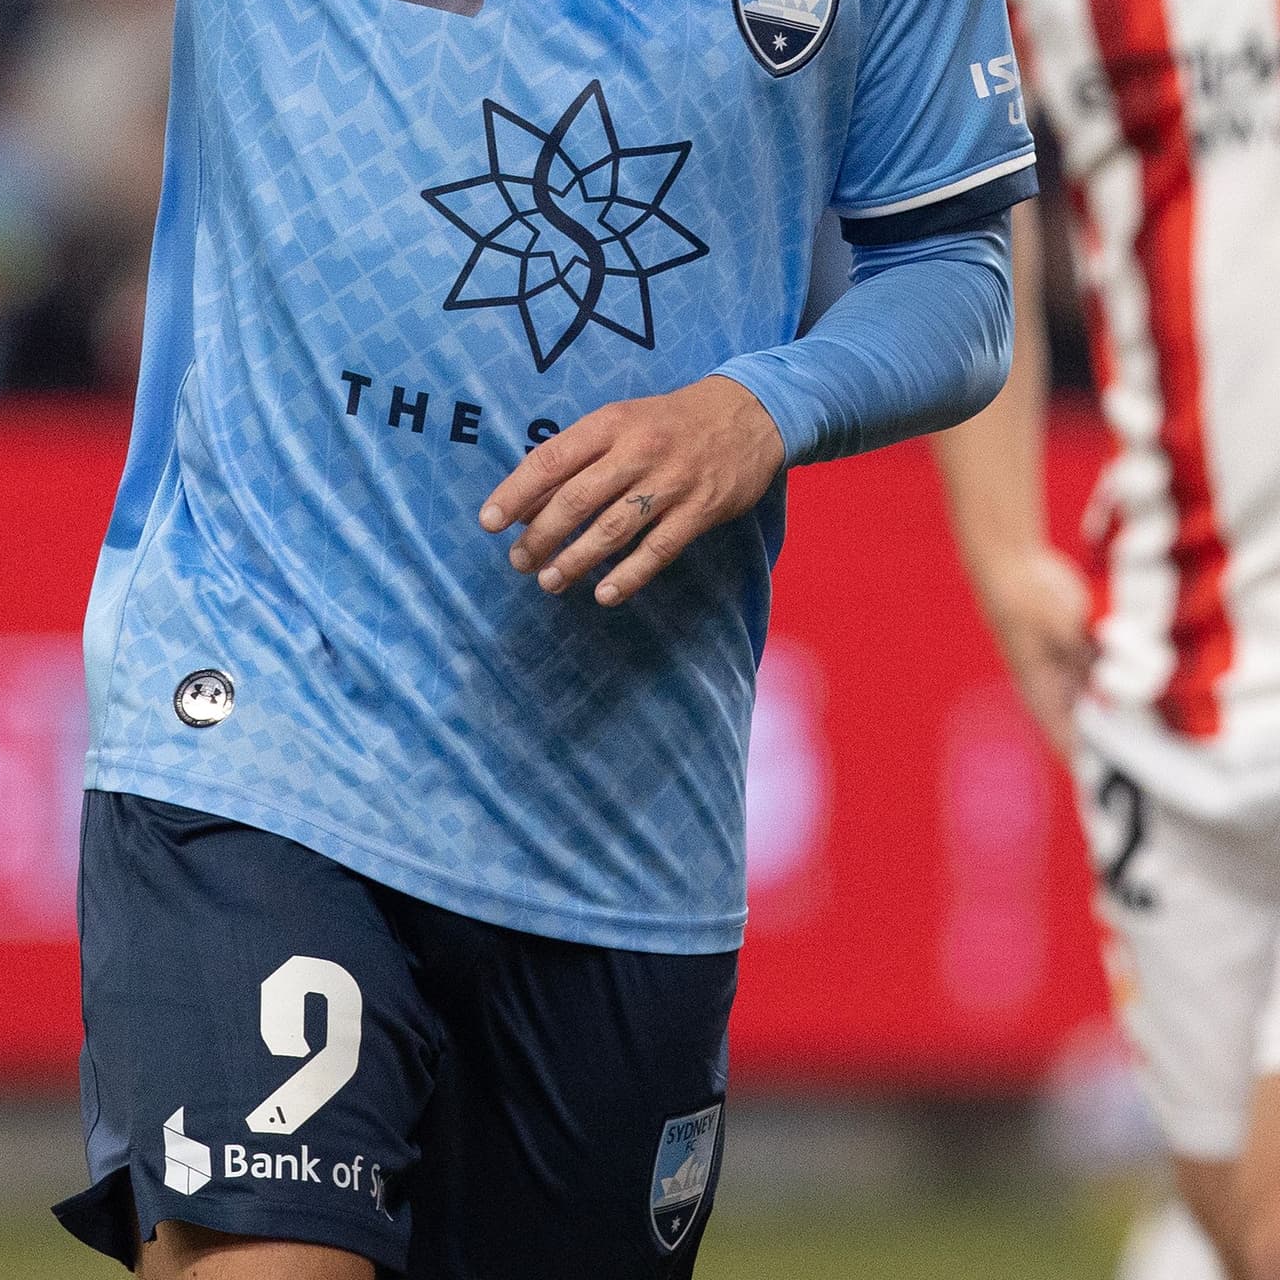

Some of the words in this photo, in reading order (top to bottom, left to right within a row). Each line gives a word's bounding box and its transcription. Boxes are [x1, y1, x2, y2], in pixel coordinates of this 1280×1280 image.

[341, 370, 483, 445] THE
[245, 955, 363, 1135] 9
[666, 1111, 717, 1145] SYDNEY
[224, 1144, 322, 1183] Bank
[332, 1155, 364, 1191] of
